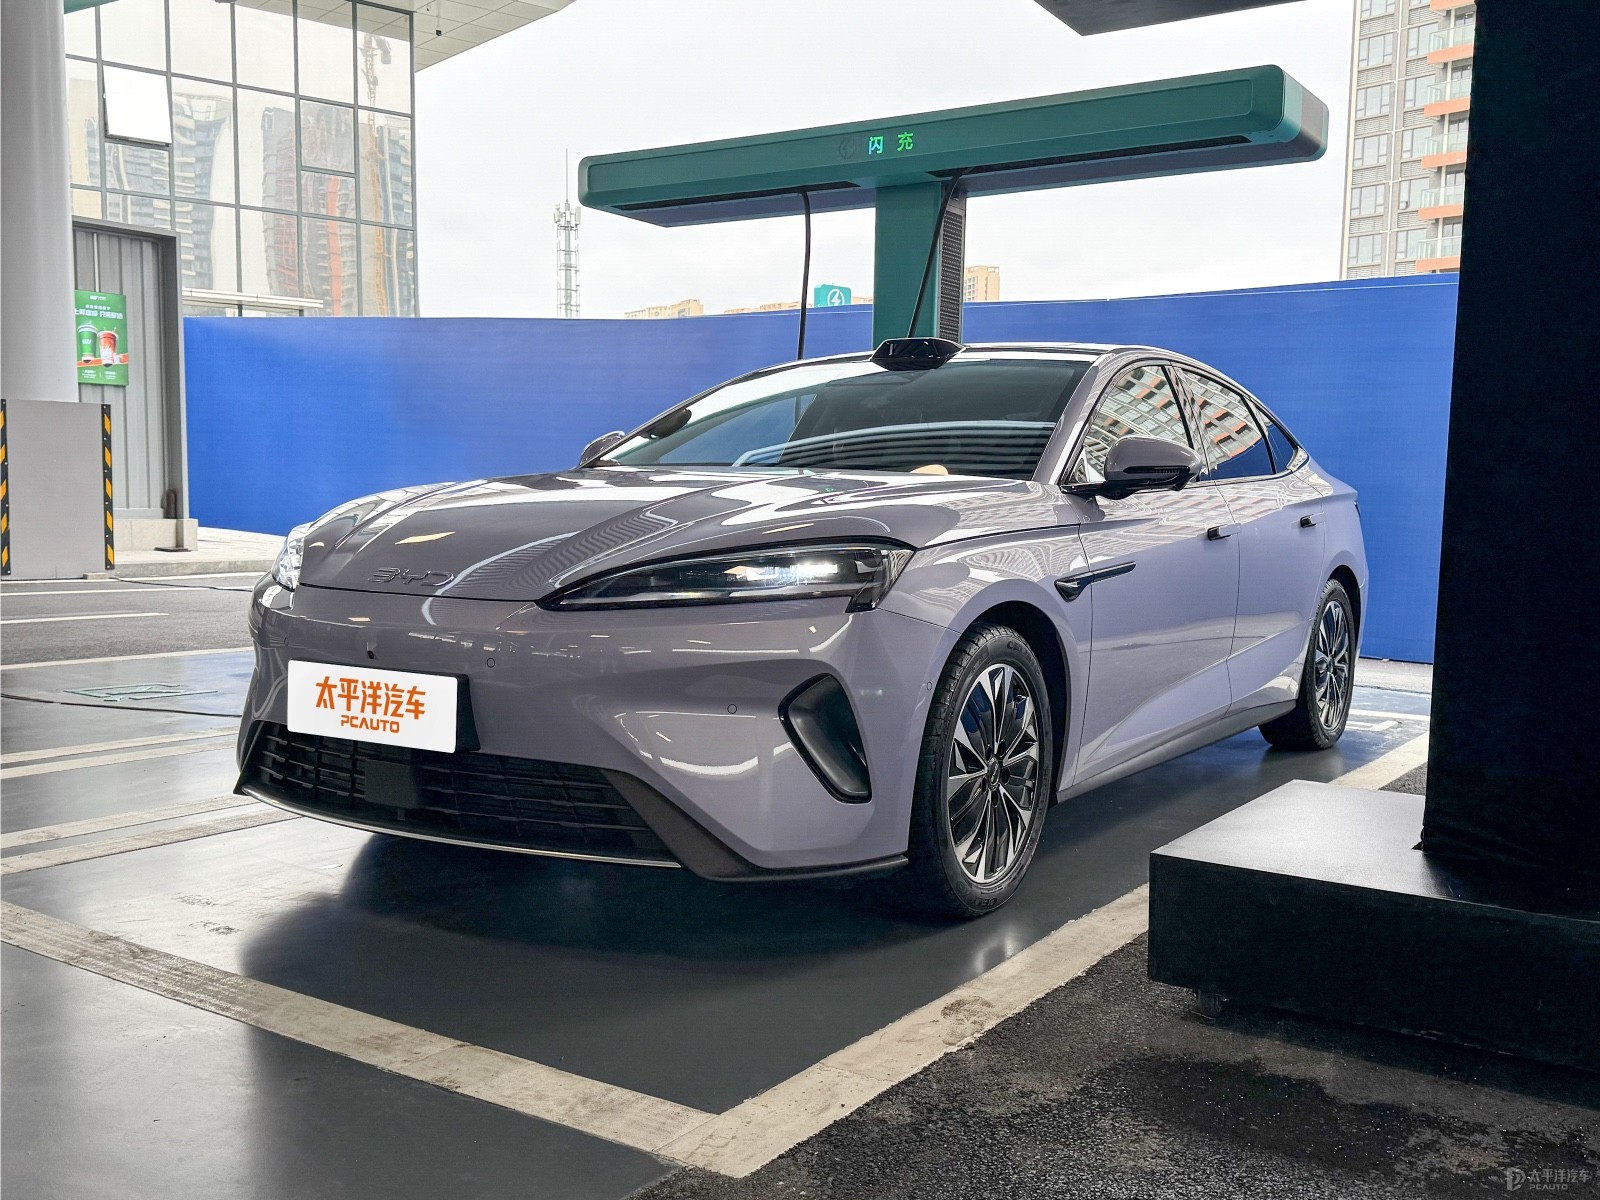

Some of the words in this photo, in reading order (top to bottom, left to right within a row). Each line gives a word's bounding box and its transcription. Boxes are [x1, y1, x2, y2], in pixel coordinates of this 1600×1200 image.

[868, 132, 914, 155] 闪充
[367, 567, 454, 587] BYD
[315, 675, 426, 720] 太平洋汽车
[340, 714, 400, 734] PCAUTO
